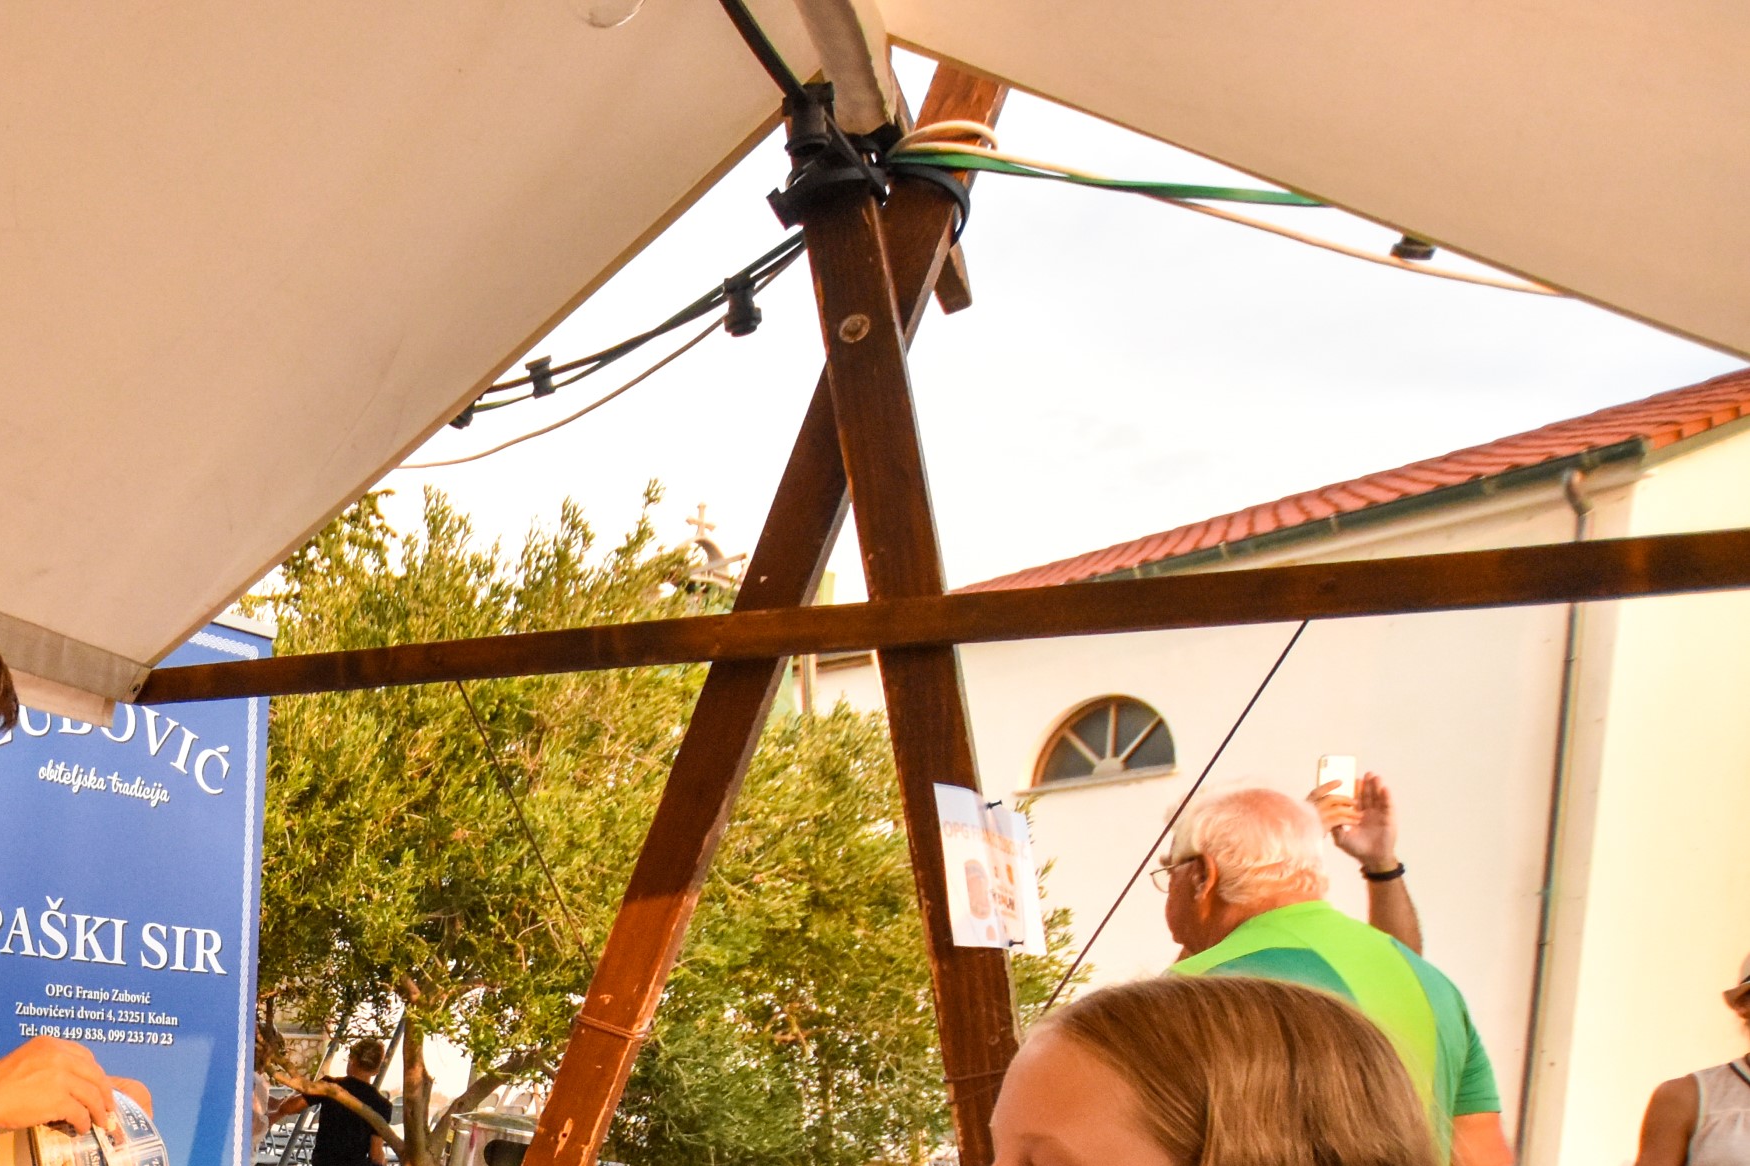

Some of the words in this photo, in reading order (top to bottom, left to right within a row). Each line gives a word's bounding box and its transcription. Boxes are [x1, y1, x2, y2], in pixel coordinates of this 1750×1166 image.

[38, 759, 107, 793] obiteljska
[107, 772, 171, 807] tradicija
[140, 922, 228, 975] SIR
[45, 983, 73, 998] OPG
[76, 986, 110, 1003] Franjo
[112, 989, 151, 1004] Zubović
[15, 1002, 75, 1018] Zubovićevi
[77, 1007, 105, 1021] dvori
[106, 1011, 116, 1023] 4,
[118, 1011, 145, 1024] 23251
[147, 1013, 179, 1026] Kolan
[19, 1023, 38, 1037] Tel:
[40, 1025, 60, 1038] 098
[63, 1027, 82, 1040] 449
[84, 1029, 106, 1042] 838,
[108, 1030, 125, 1042] 099
[128, 1031, 144, 1044] 233
[147, 1032, 158, 1045] 70
[161, 1033, 173, 1045] 23
